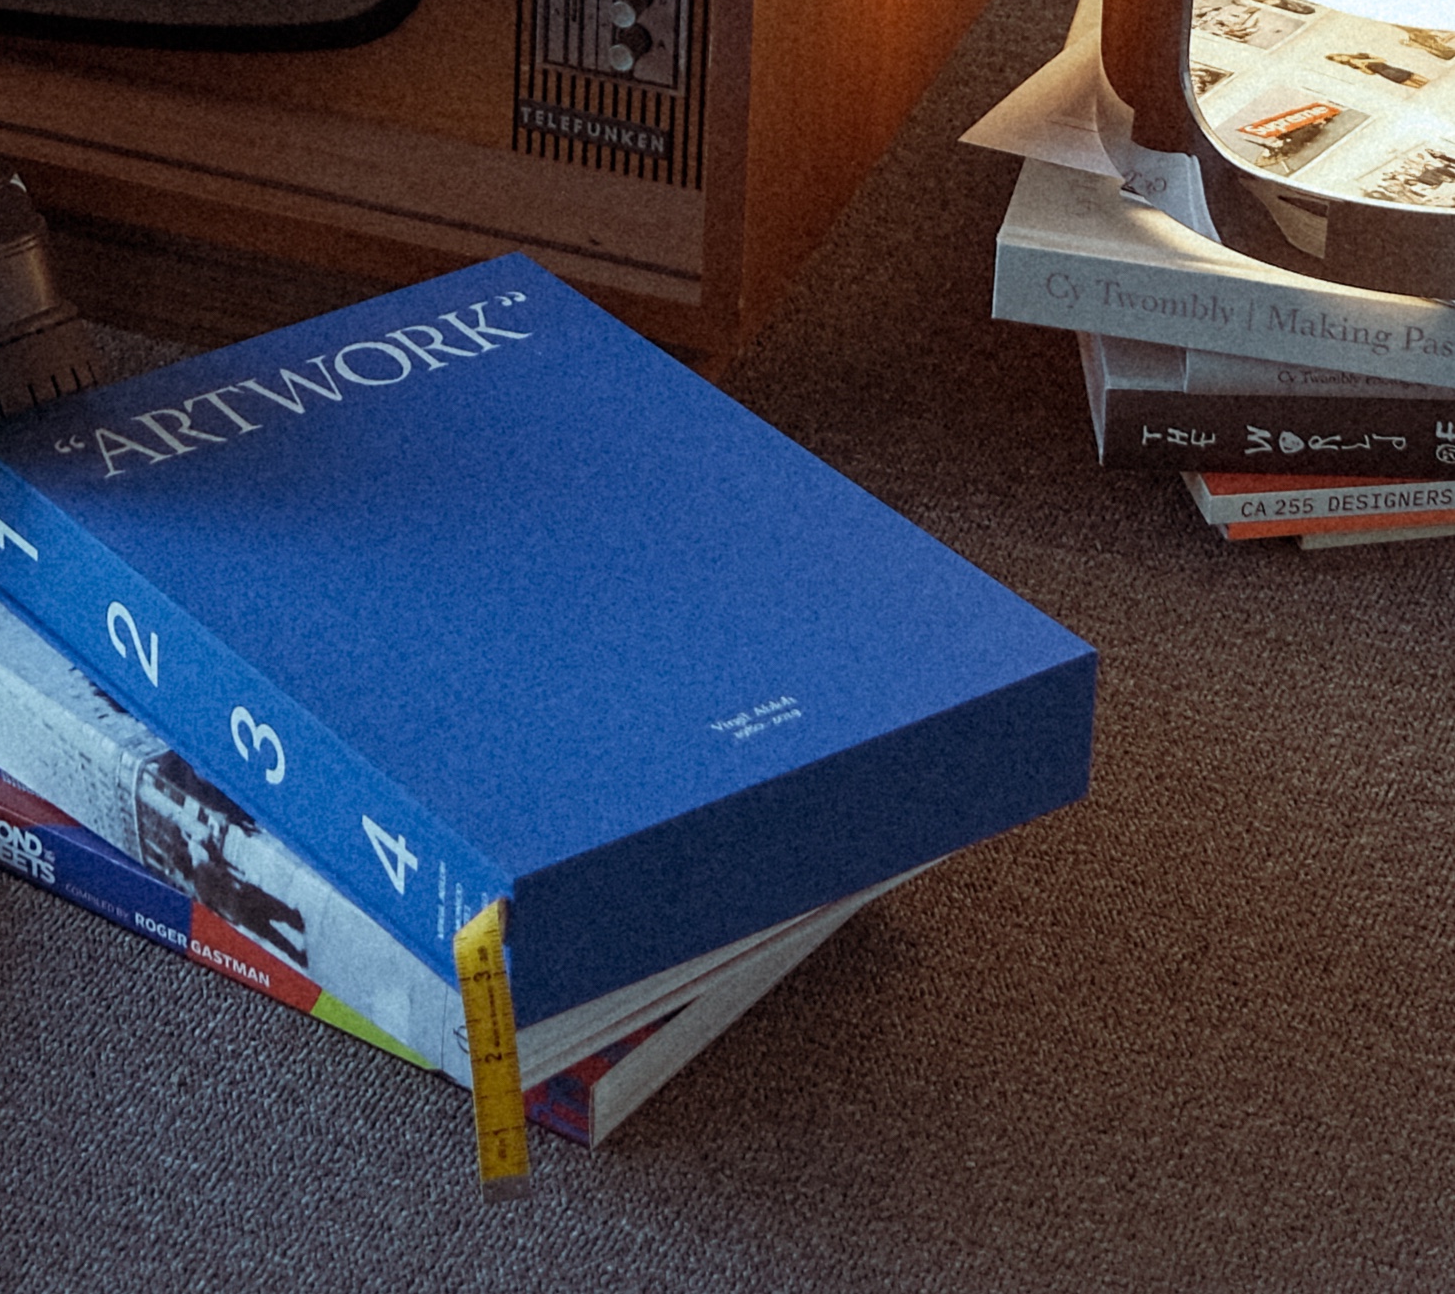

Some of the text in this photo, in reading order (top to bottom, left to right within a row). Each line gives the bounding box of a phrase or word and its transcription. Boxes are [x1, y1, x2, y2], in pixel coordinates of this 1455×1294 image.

[520, 107, 665, 154] TELEFUNKEN
[1046, 272, 1082, 310] Cy
[1096, 279, 1235, 327] Twombly
[1267, 305, 1394, 357] Making
[54, 289, 533, 479] “ARTWORK”
[1142, 425, 1216, 446] THE
[1241, 487, 1454, 518] CA 255 DESIGNERS
[107, 601, 158, 687] 2
[231, 706, 285, 785] 3
[362, 814, 419, 895] 4
[135, 912, 270, 988] ROGER GASTMAN
[473, 969, 492, 983] 3
[484, 1051, 503, 1065] 2
